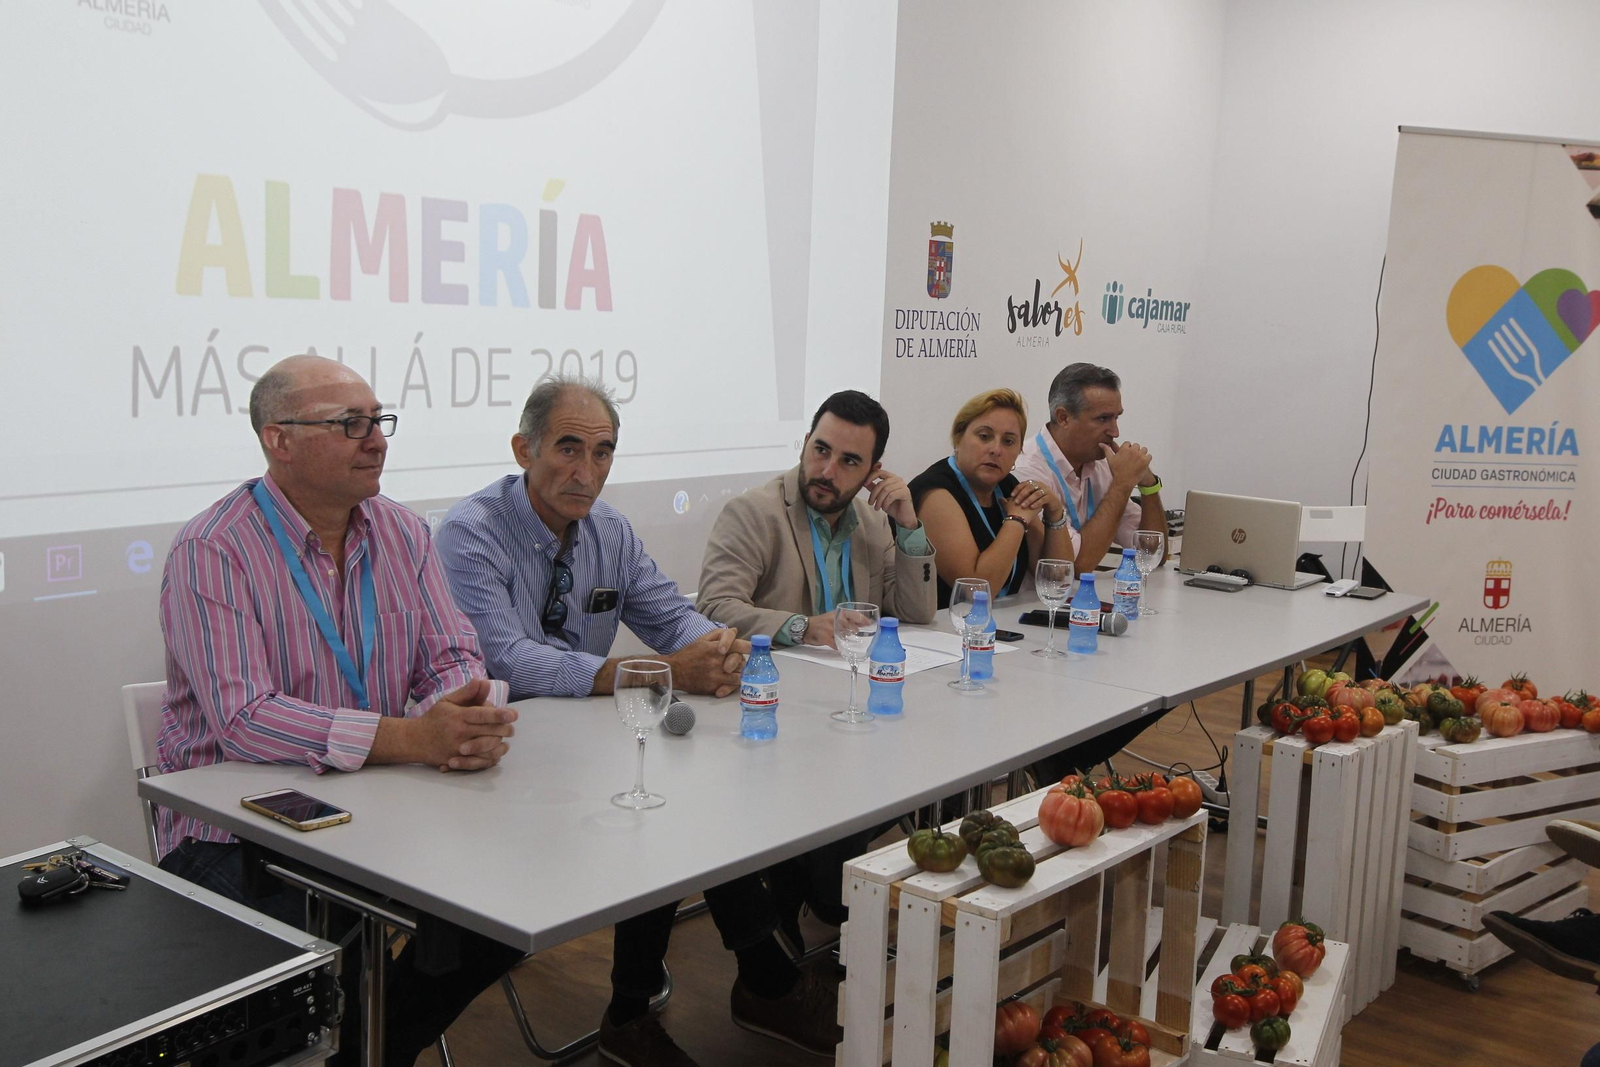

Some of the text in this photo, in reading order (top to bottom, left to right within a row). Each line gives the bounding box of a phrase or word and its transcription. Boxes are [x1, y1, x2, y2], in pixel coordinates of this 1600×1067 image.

[103, 15, 152, 37] CIUDAD
[174, 172, 614, 312] ALMERÍA
[895, 306, 981, 332] DIPUTACIÓN
[1006, 278, 1086, 337] sabores
[1127, 288, 1191, 329] cajamar
[1156, 322, 1187, 335] CAJA RURAL
[895, 333, 978, 359] DE ALMERÍA
[131, 328, 271, 418] MÁS
[303, 331, 434, 411] LÁ
[450, 346, 513, 408] DE
[1434, 420, 1580, 457] ALMERÍA
[1431, 467, 1576, 483] CIUDAD GASTRONÓMICA
[1426, 497, 1572, 525] ¡Para comérsela!
[1232, 528, 1247, 545] hp
[55, 553, 74, 572] Pr
[1458, 613, 1532, 633] ALMERÍA
[1474, 635, 1513, 646] CIUDAD
